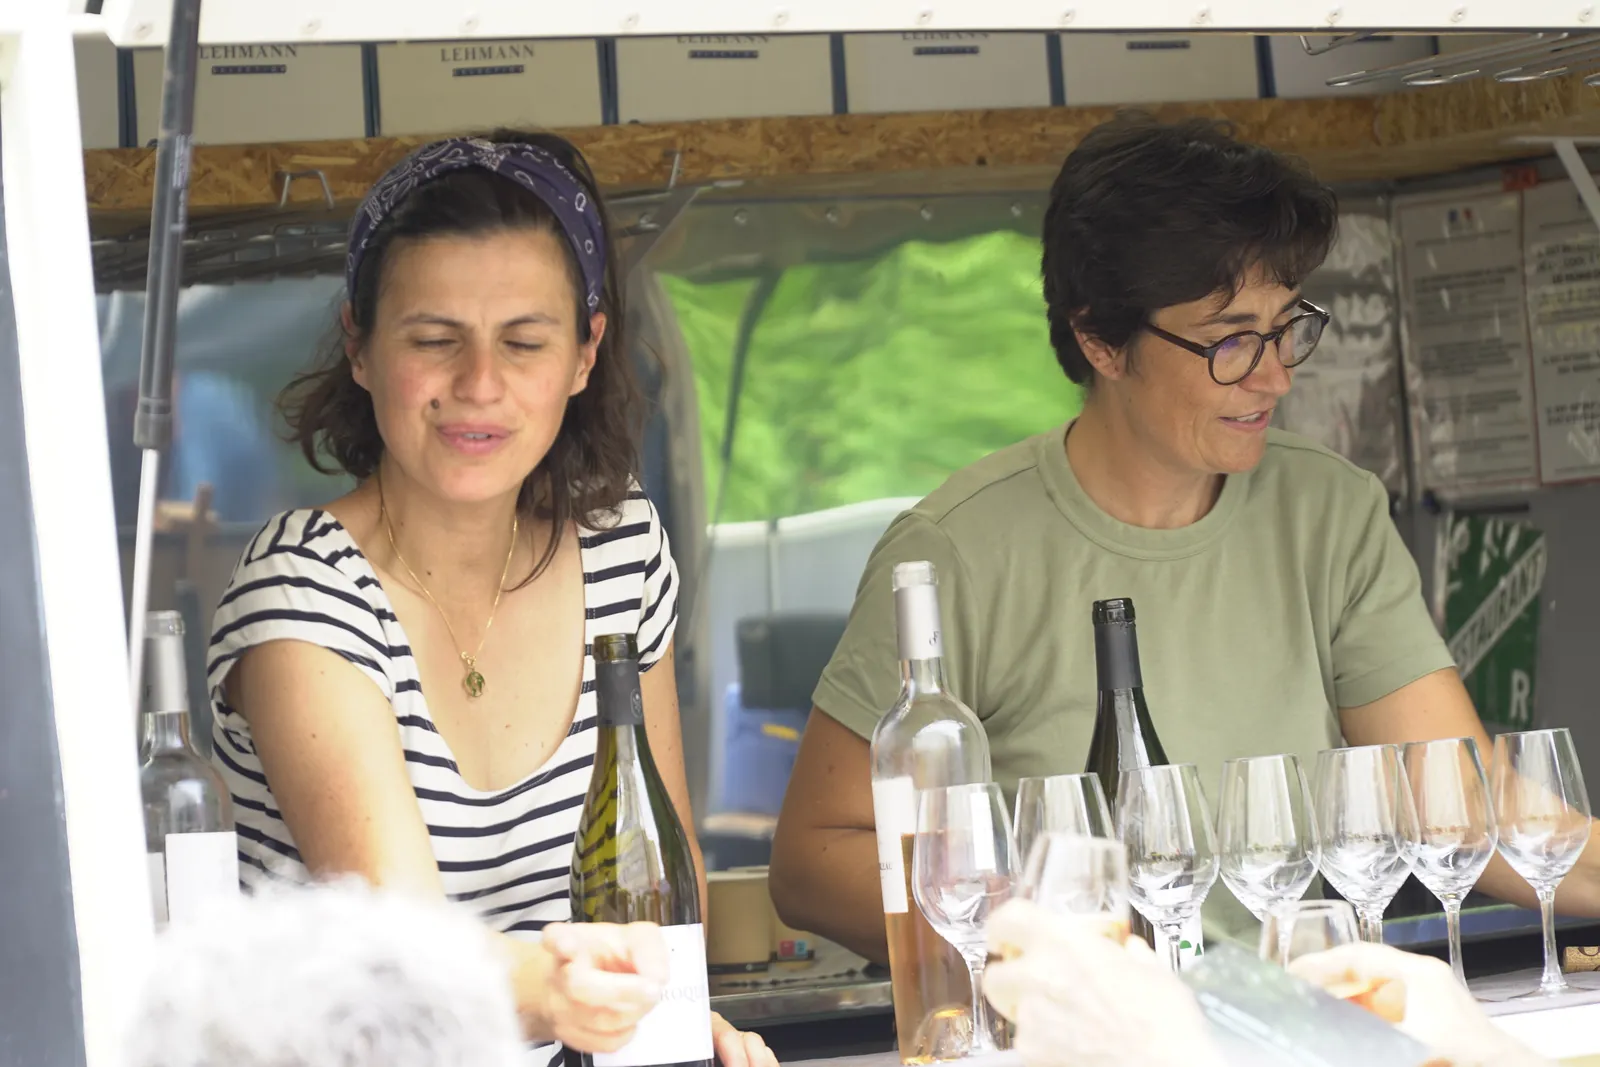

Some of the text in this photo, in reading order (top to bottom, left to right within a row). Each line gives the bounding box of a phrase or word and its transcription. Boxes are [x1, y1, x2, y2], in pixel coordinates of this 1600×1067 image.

[199, 44, 298, 60] LEHMANN
[441, 43, 535, 62] LEHMANN
[1510, 669, 1531, 721] R
